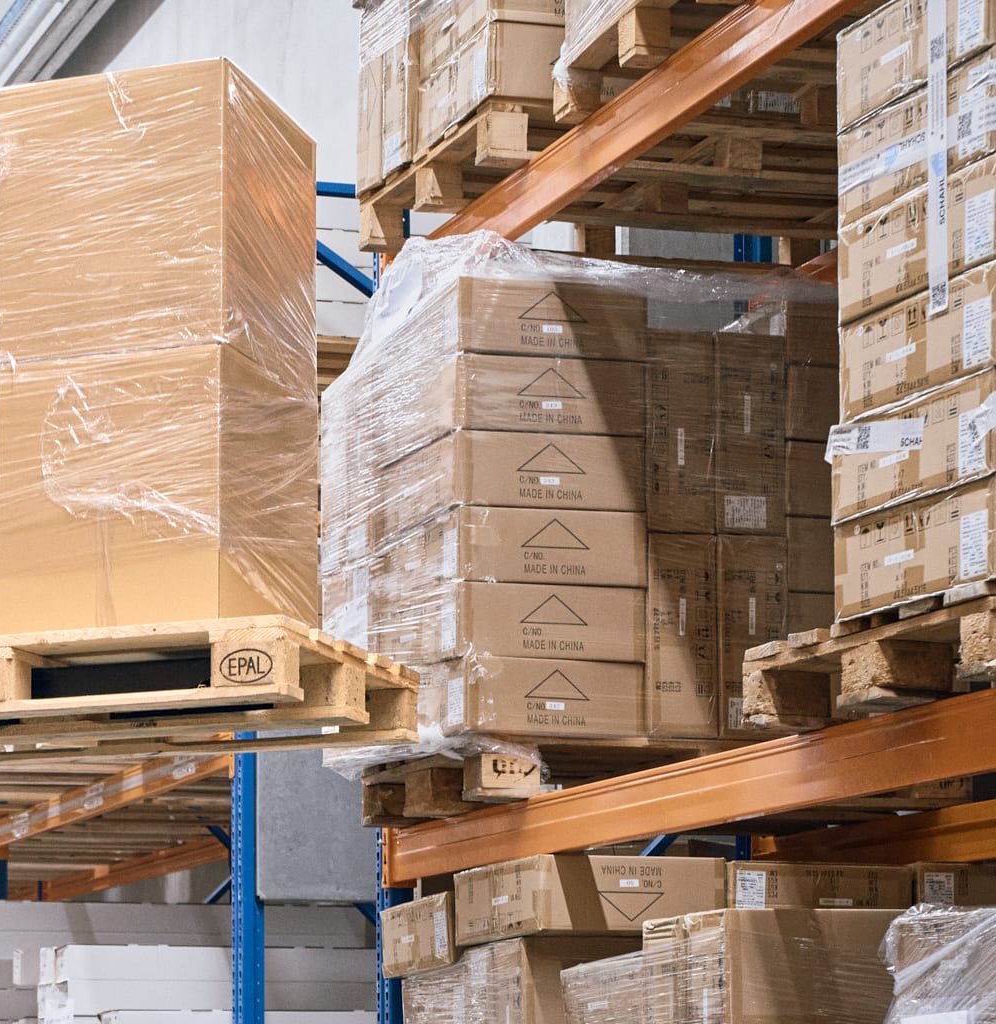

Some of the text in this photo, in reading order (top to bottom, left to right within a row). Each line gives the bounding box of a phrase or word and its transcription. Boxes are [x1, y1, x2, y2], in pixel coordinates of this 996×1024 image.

[520, 412, 582, 424] MADE IN CHINA
[520, 488, 582, 501] MADE IN CHINA
[524, 563, 586, 576] MADE IN CHINA
[523, 639, 584, 651] MADE IN CHINA
[228, 656, 265, 676] EPAL
[527, 713, 586, 726] MADE IN CHINA
[601, 865, 662, 876] MADE IN CHINA
